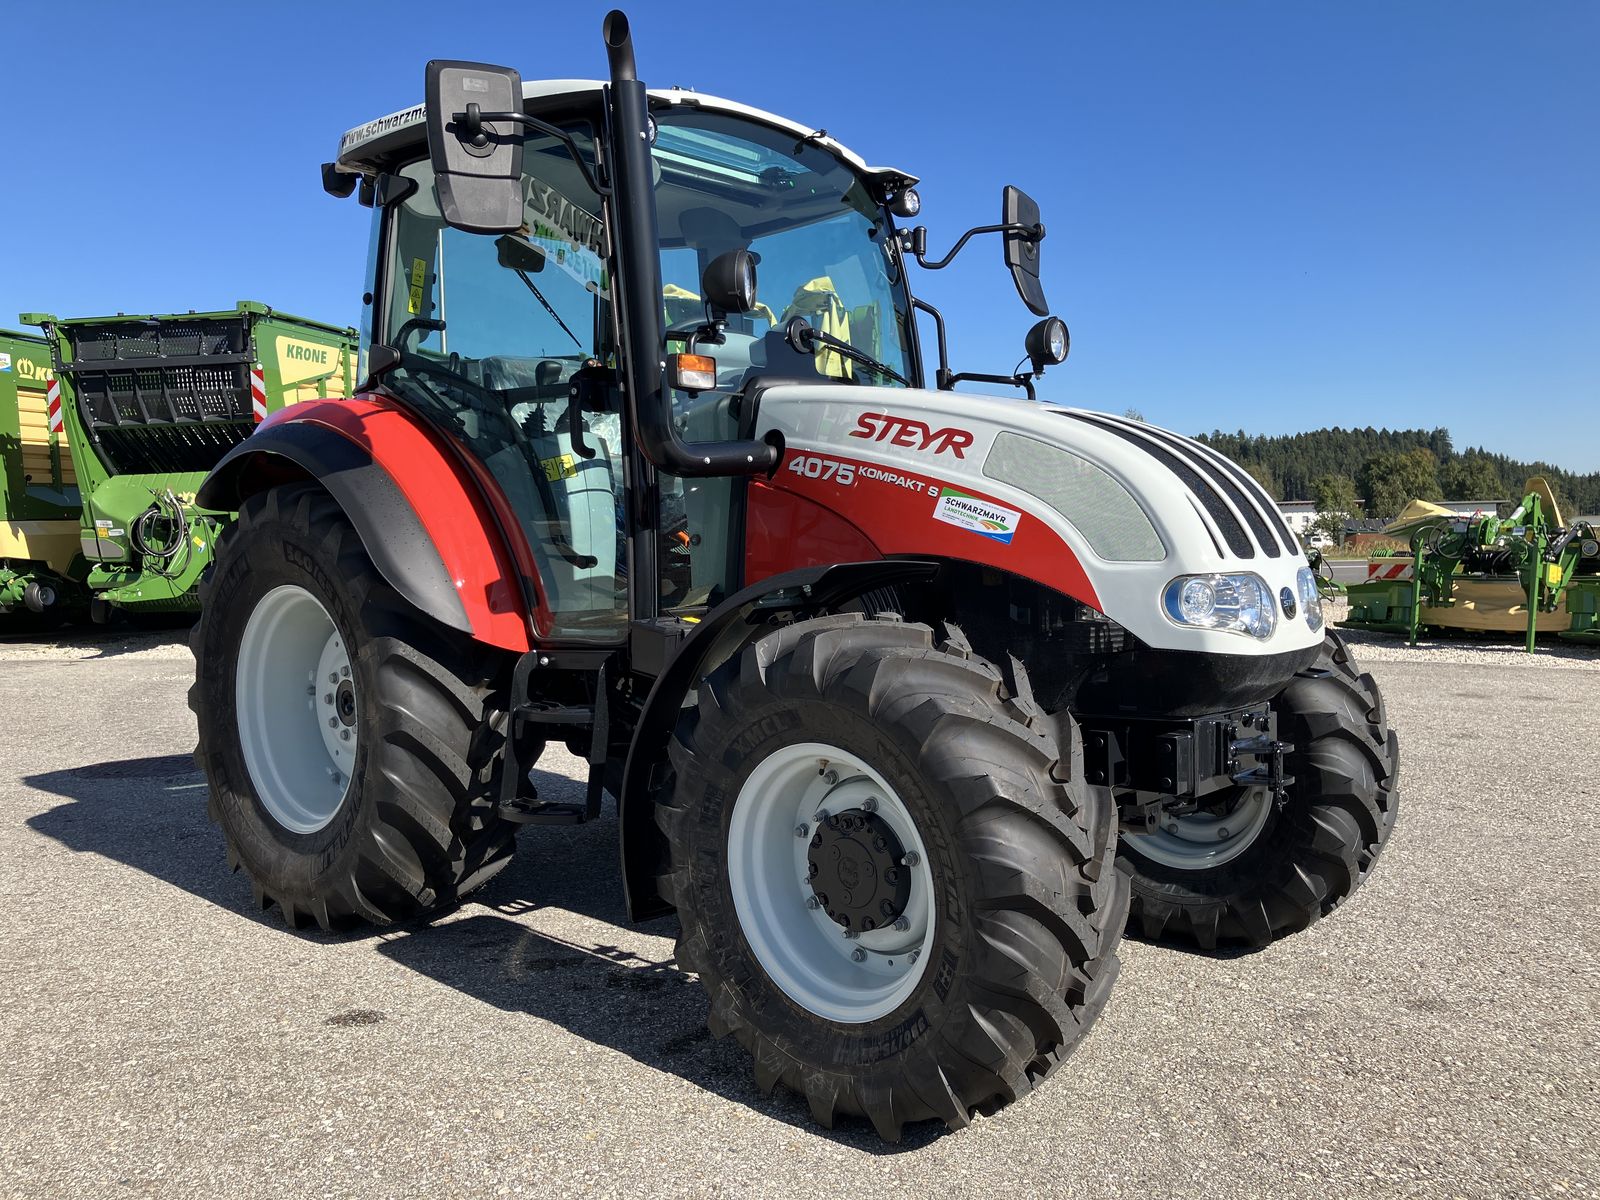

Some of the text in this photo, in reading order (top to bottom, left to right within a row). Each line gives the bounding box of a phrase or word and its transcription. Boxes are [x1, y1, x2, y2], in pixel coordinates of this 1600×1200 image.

[286, 344, 328, 365] KRONE
[848, 411, 974, 460] STEYR
[788, 455, 940, 498] 4075 KOMPAKT S
[943, 506, 980, 522] LANDTECHNIK
[945, 497, 1007, 524] SCHWARZMAYR
